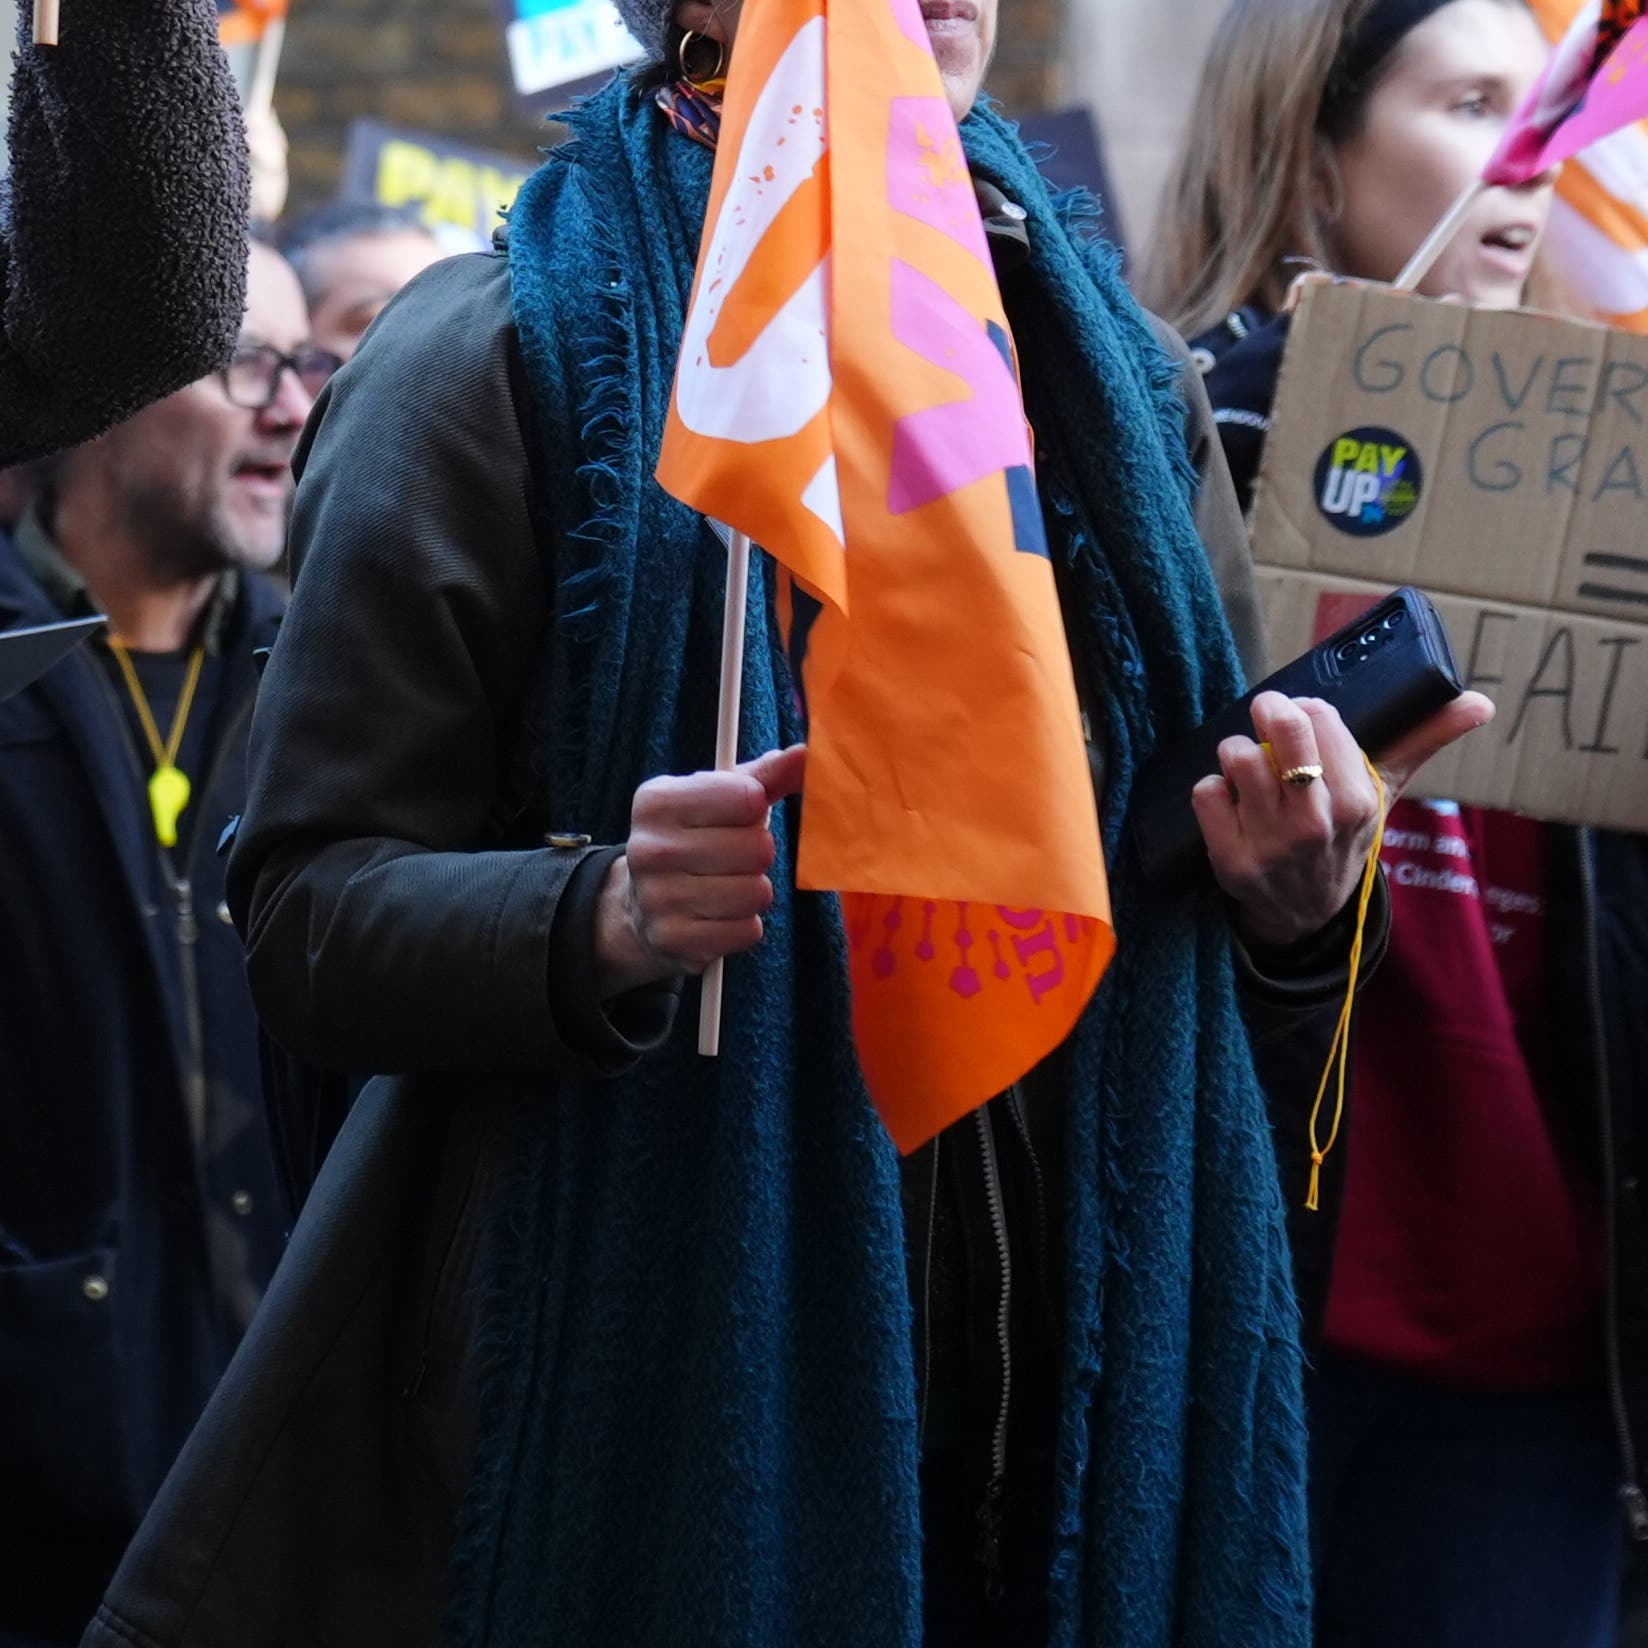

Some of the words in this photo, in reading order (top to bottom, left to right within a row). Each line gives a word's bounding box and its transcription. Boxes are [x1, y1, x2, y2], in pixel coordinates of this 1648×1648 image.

[1333, 438, 1408, 477] PAY
[1467, 421, 1644, 502] GRA
[1322, 467, 1381, 517] UP
[1463, 608, 1648, 759] FAI
[1383, 827, 1431, 851] orm
